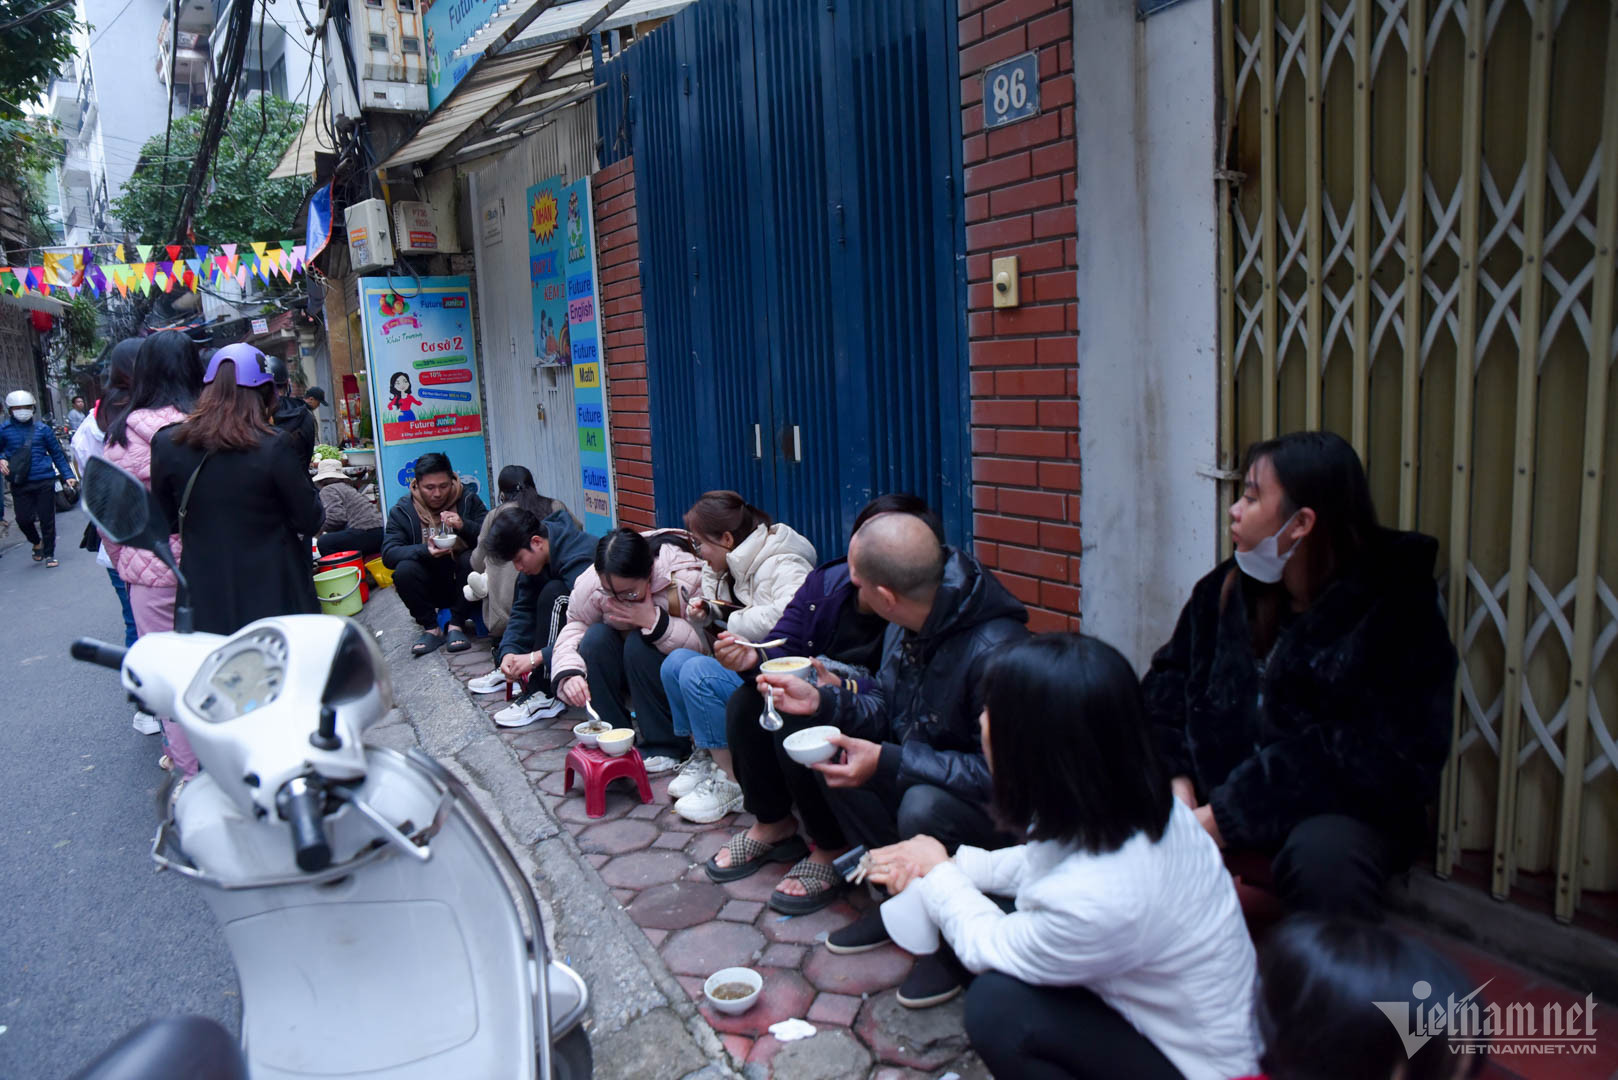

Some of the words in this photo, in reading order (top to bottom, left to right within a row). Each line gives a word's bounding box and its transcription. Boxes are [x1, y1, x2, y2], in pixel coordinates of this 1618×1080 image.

[993, 67, 1027, 115] 86
[568, 278, 591, 296] Future
[570, 301, 593, 322] English
[421, 341, 435, 353] Cơ
[437, 339, 451, 352] sở
[453, 336, 464, 350] 2
[573, 344, 597, 359] Future
[579, 367, 595, 383] Math
[578, 407, 602, 423] Future
[410, 420, 435, 430] Future
[586, 431, 597, 447] Art
[583, 469, 607, 488] Future
